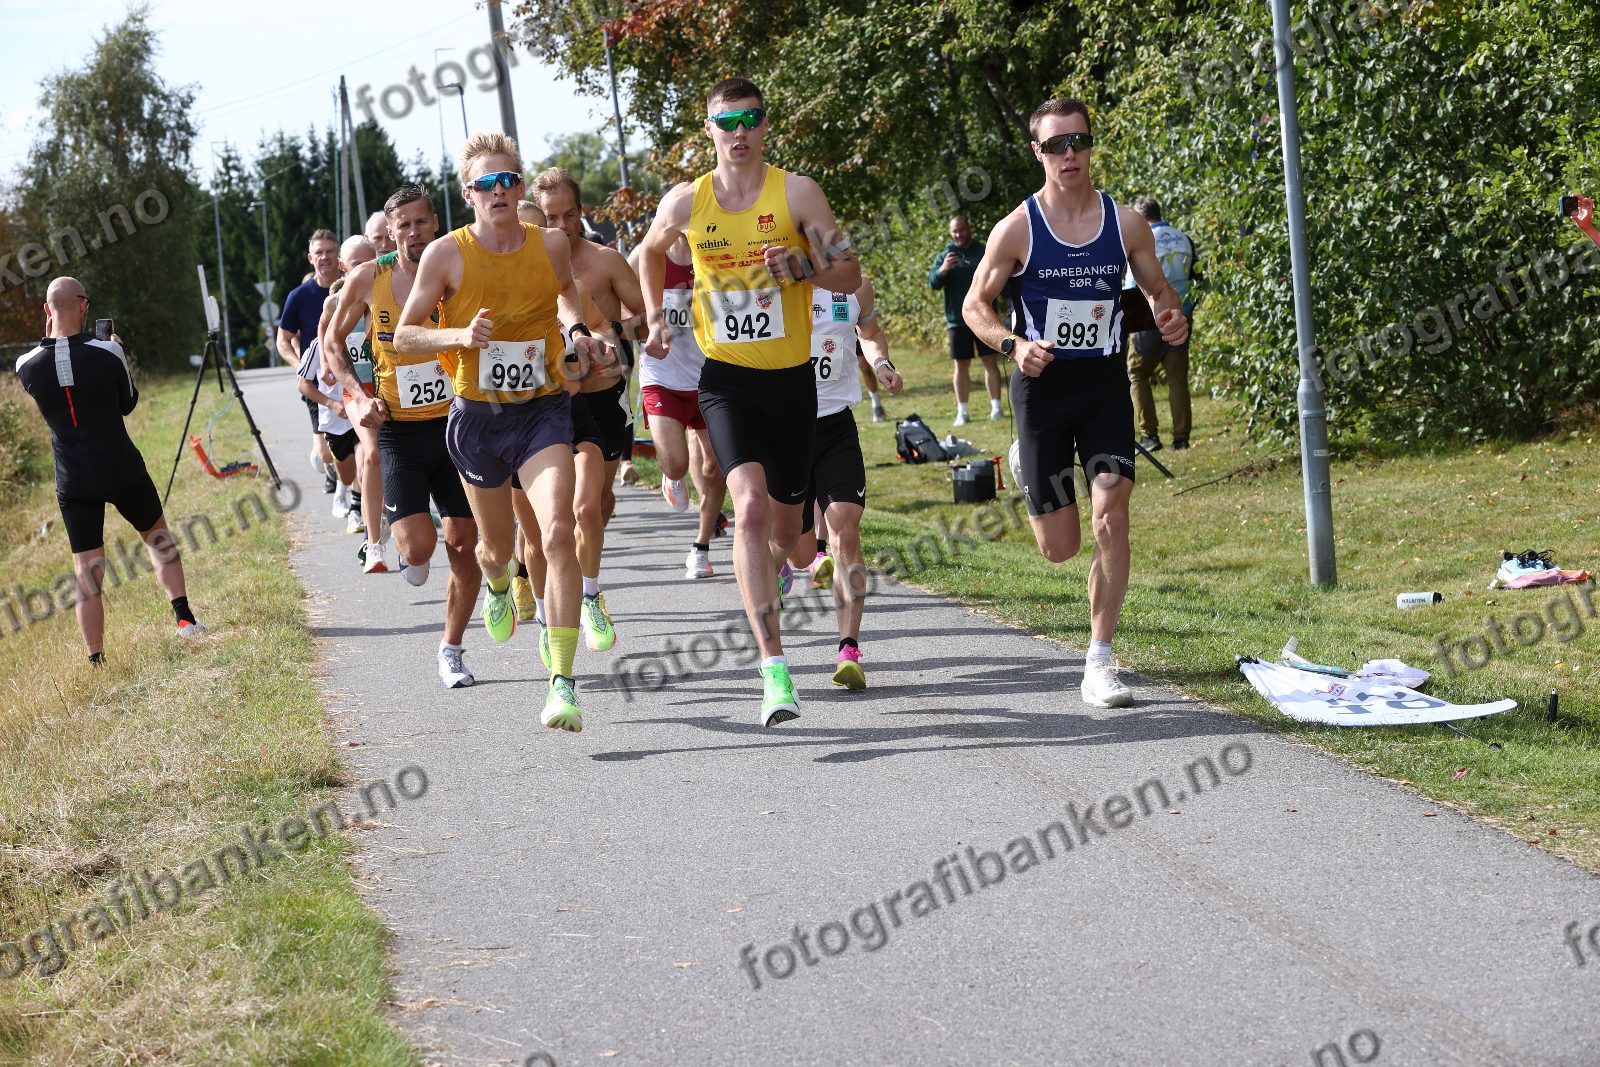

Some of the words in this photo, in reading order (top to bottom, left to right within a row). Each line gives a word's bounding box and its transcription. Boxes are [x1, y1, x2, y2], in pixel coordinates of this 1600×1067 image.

[1038, 264, 1120, 279] SPAREBANKEN
[1069, 277, 1092, 288] SØR
[725, 312, 771, 340] 942
[1056, 322, 1099, 347] 993
[491, 363, 534, 389] 992
[409, 379, 447, 405] 252
[465, 469, 484, 482] HOKA
